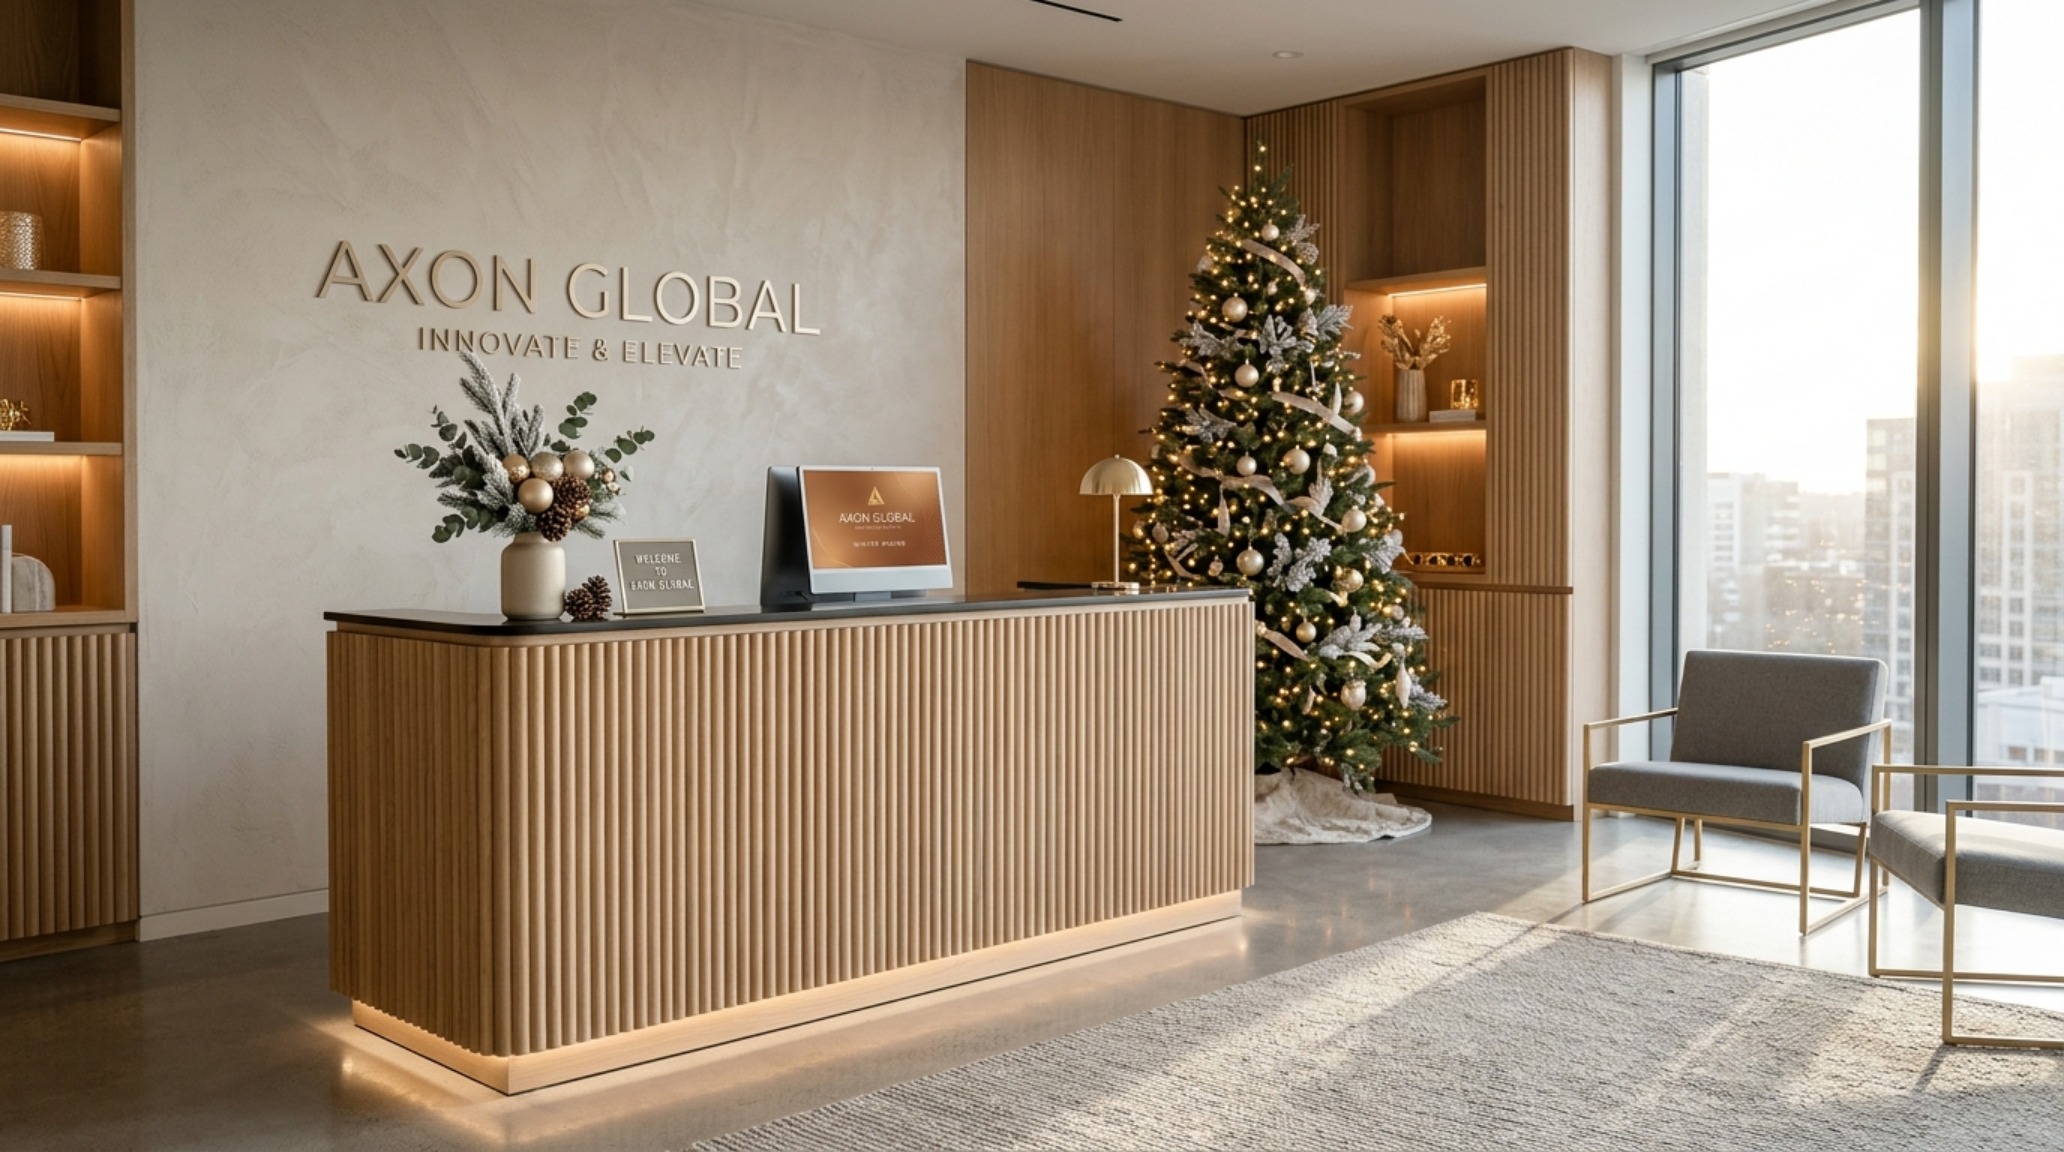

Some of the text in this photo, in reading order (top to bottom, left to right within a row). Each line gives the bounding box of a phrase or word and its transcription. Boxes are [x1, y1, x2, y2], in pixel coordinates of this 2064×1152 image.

[314, 239, 821, 336] AXON GLOBAL
[417, 326, 744, 369] INNOVATE & ELEVATE
[655, 566, 667, 577] TO
